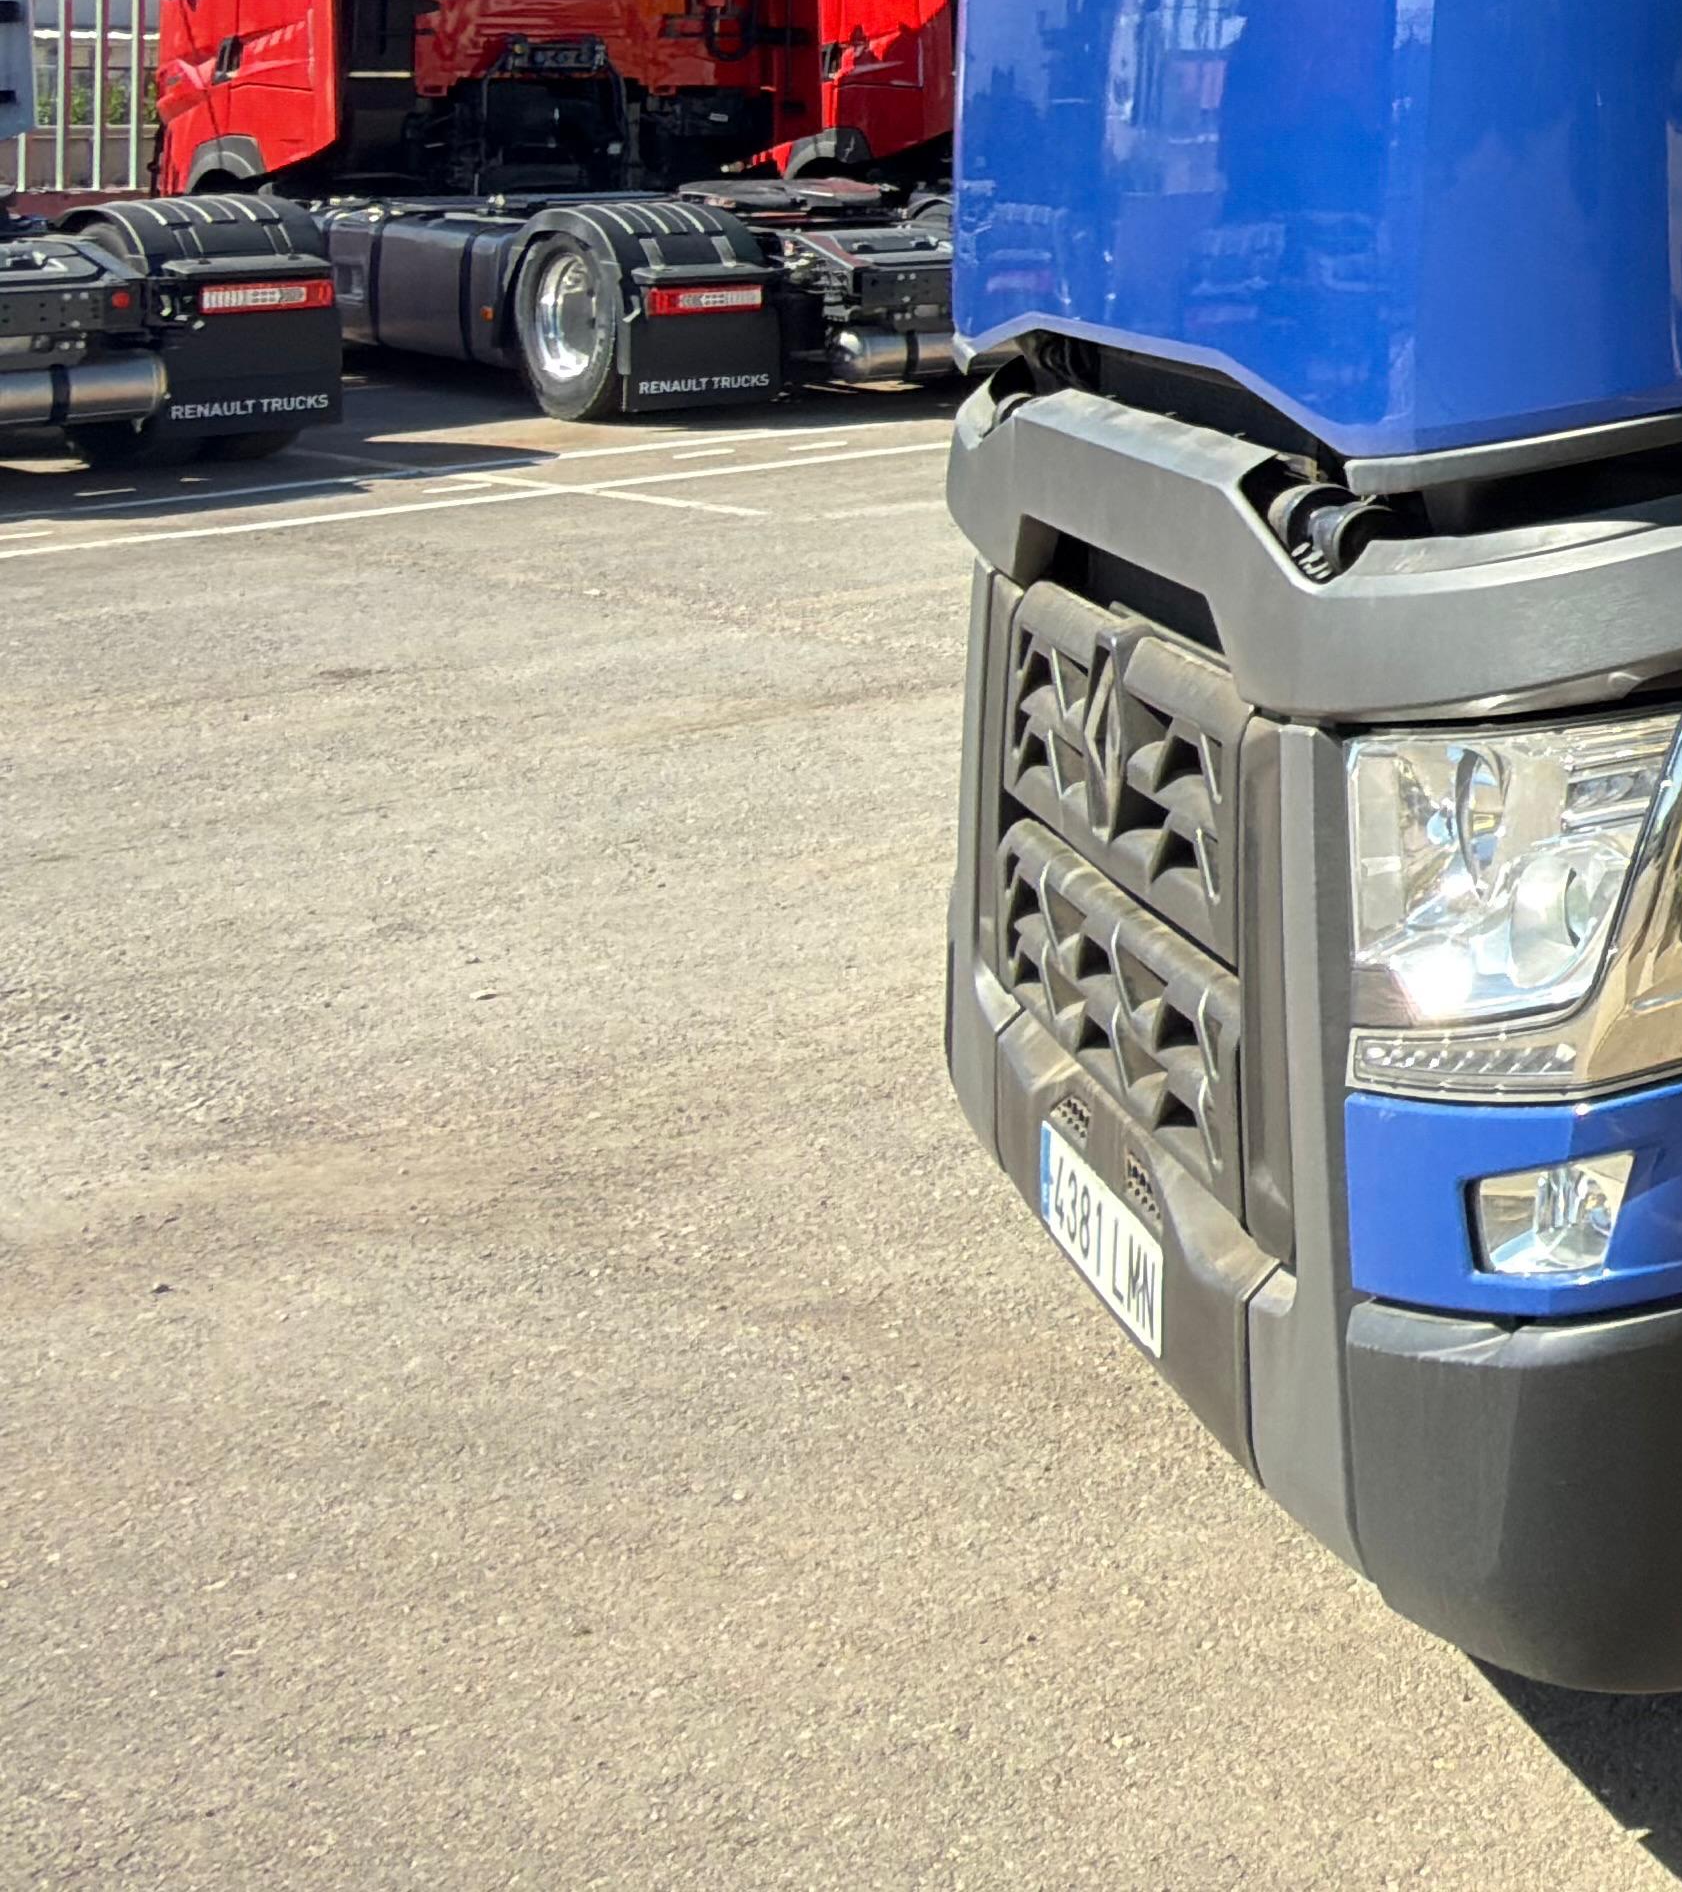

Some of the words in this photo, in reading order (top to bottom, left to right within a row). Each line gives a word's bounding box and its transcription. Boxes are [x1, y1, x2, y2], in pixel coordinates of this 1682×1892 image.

[639, 377, 709, 395] RENAULT
[711, 373, 770, 389] TRUCKS
[171, 399, 257, 420] RENAULT
[260, 394, 329, 412] TRUCKS
[1054, 1155, 1103, 1278] 4381
